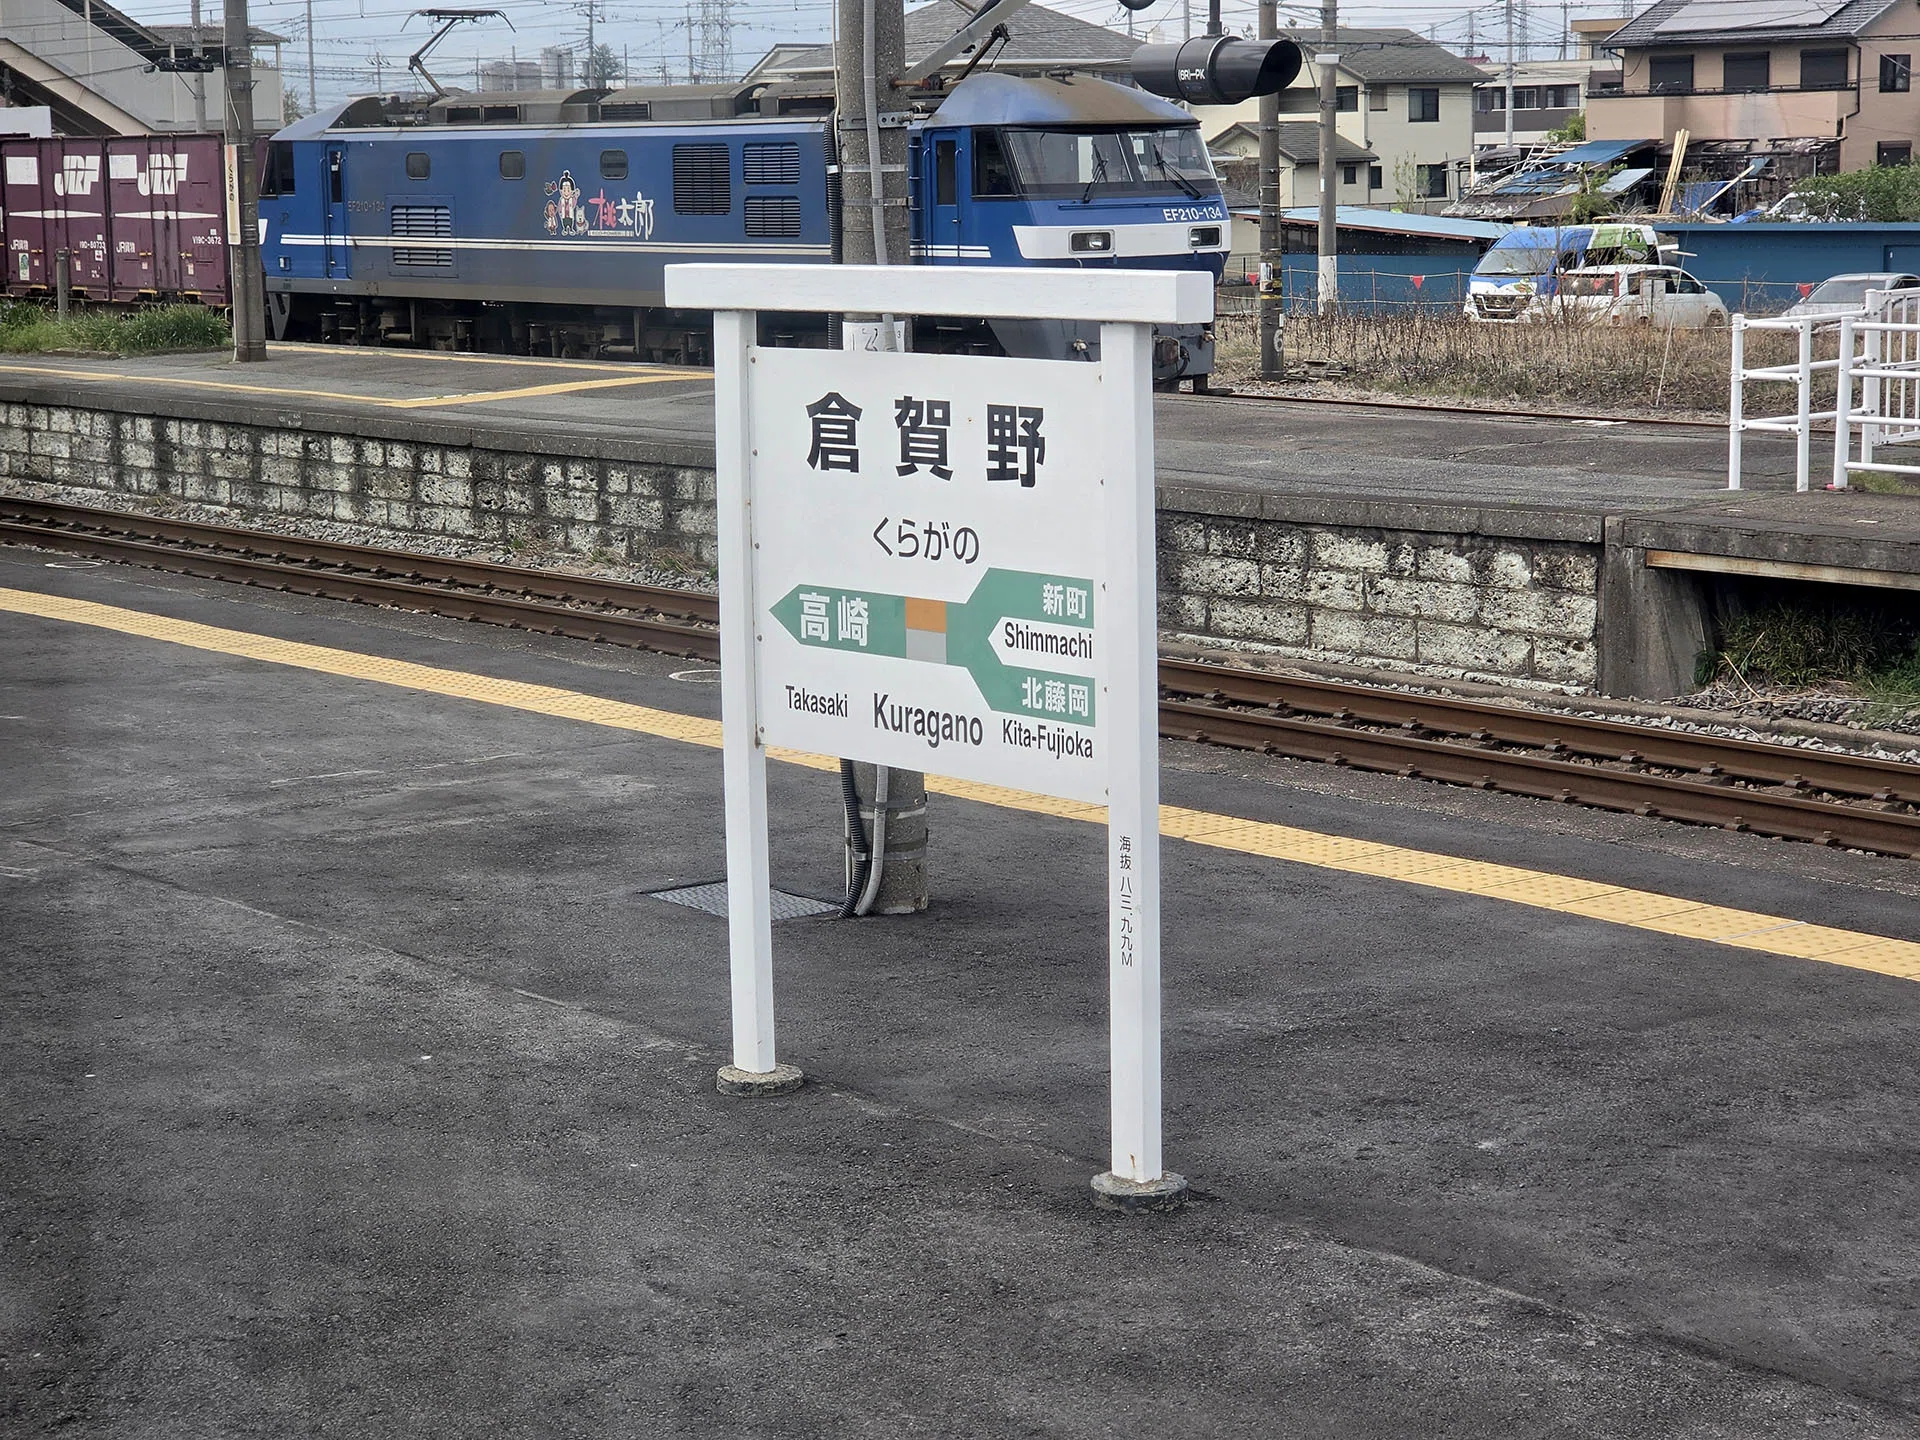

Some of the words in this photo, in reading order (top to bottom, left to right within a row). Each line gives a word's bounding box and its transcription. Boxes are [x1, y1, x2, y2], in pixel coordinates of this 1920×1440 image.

[588, 188, 654, 240] 桃太郎
[1163, 206, 1223, 221] EF210-134
[805, 391, 1046, 488] 倉賀野
[872, 516, 980, 564] くらがの
[799, 592, 869, 647] 高崎
[1042, 582, 1088, 620] 新町
[1004, 621, 1093, 659] Shimmachi
[785, 685, 848, 718] Takasaki
[1021, 676, 1089, 717] 北藤岡
[873, 693, 983, 748] Kuragano
[1002, 718, 1093, 760] Kita-Fujioka
